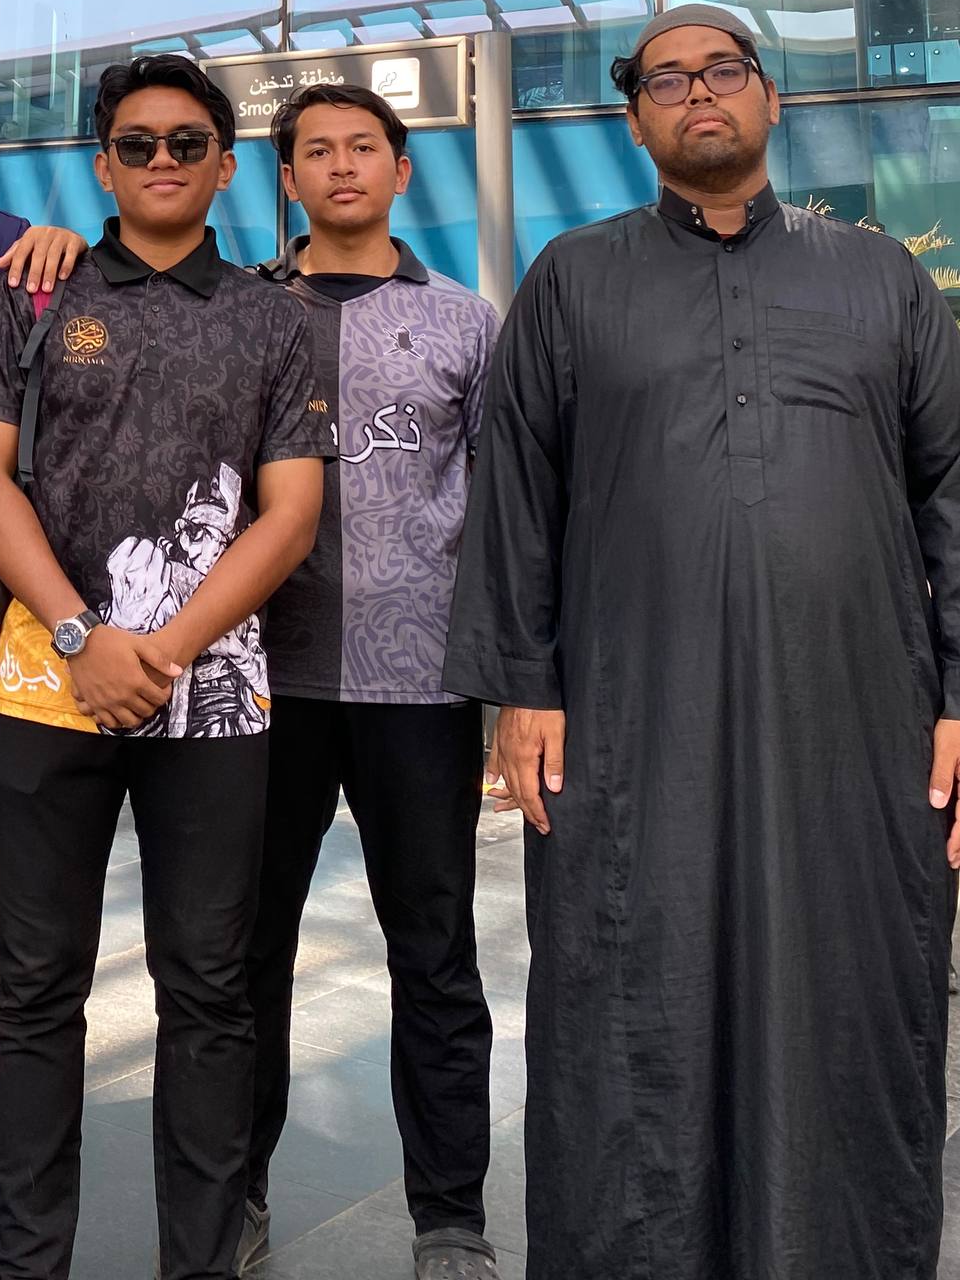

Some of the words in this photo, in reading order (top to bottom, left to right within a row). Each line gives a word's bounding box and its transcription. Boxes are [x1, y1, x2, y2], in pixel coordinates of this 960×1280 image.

[249, 74, 294, 95] تدخين
[299, 68, 345, 86] منطقة
[238, 98, 287, 117] Smok
